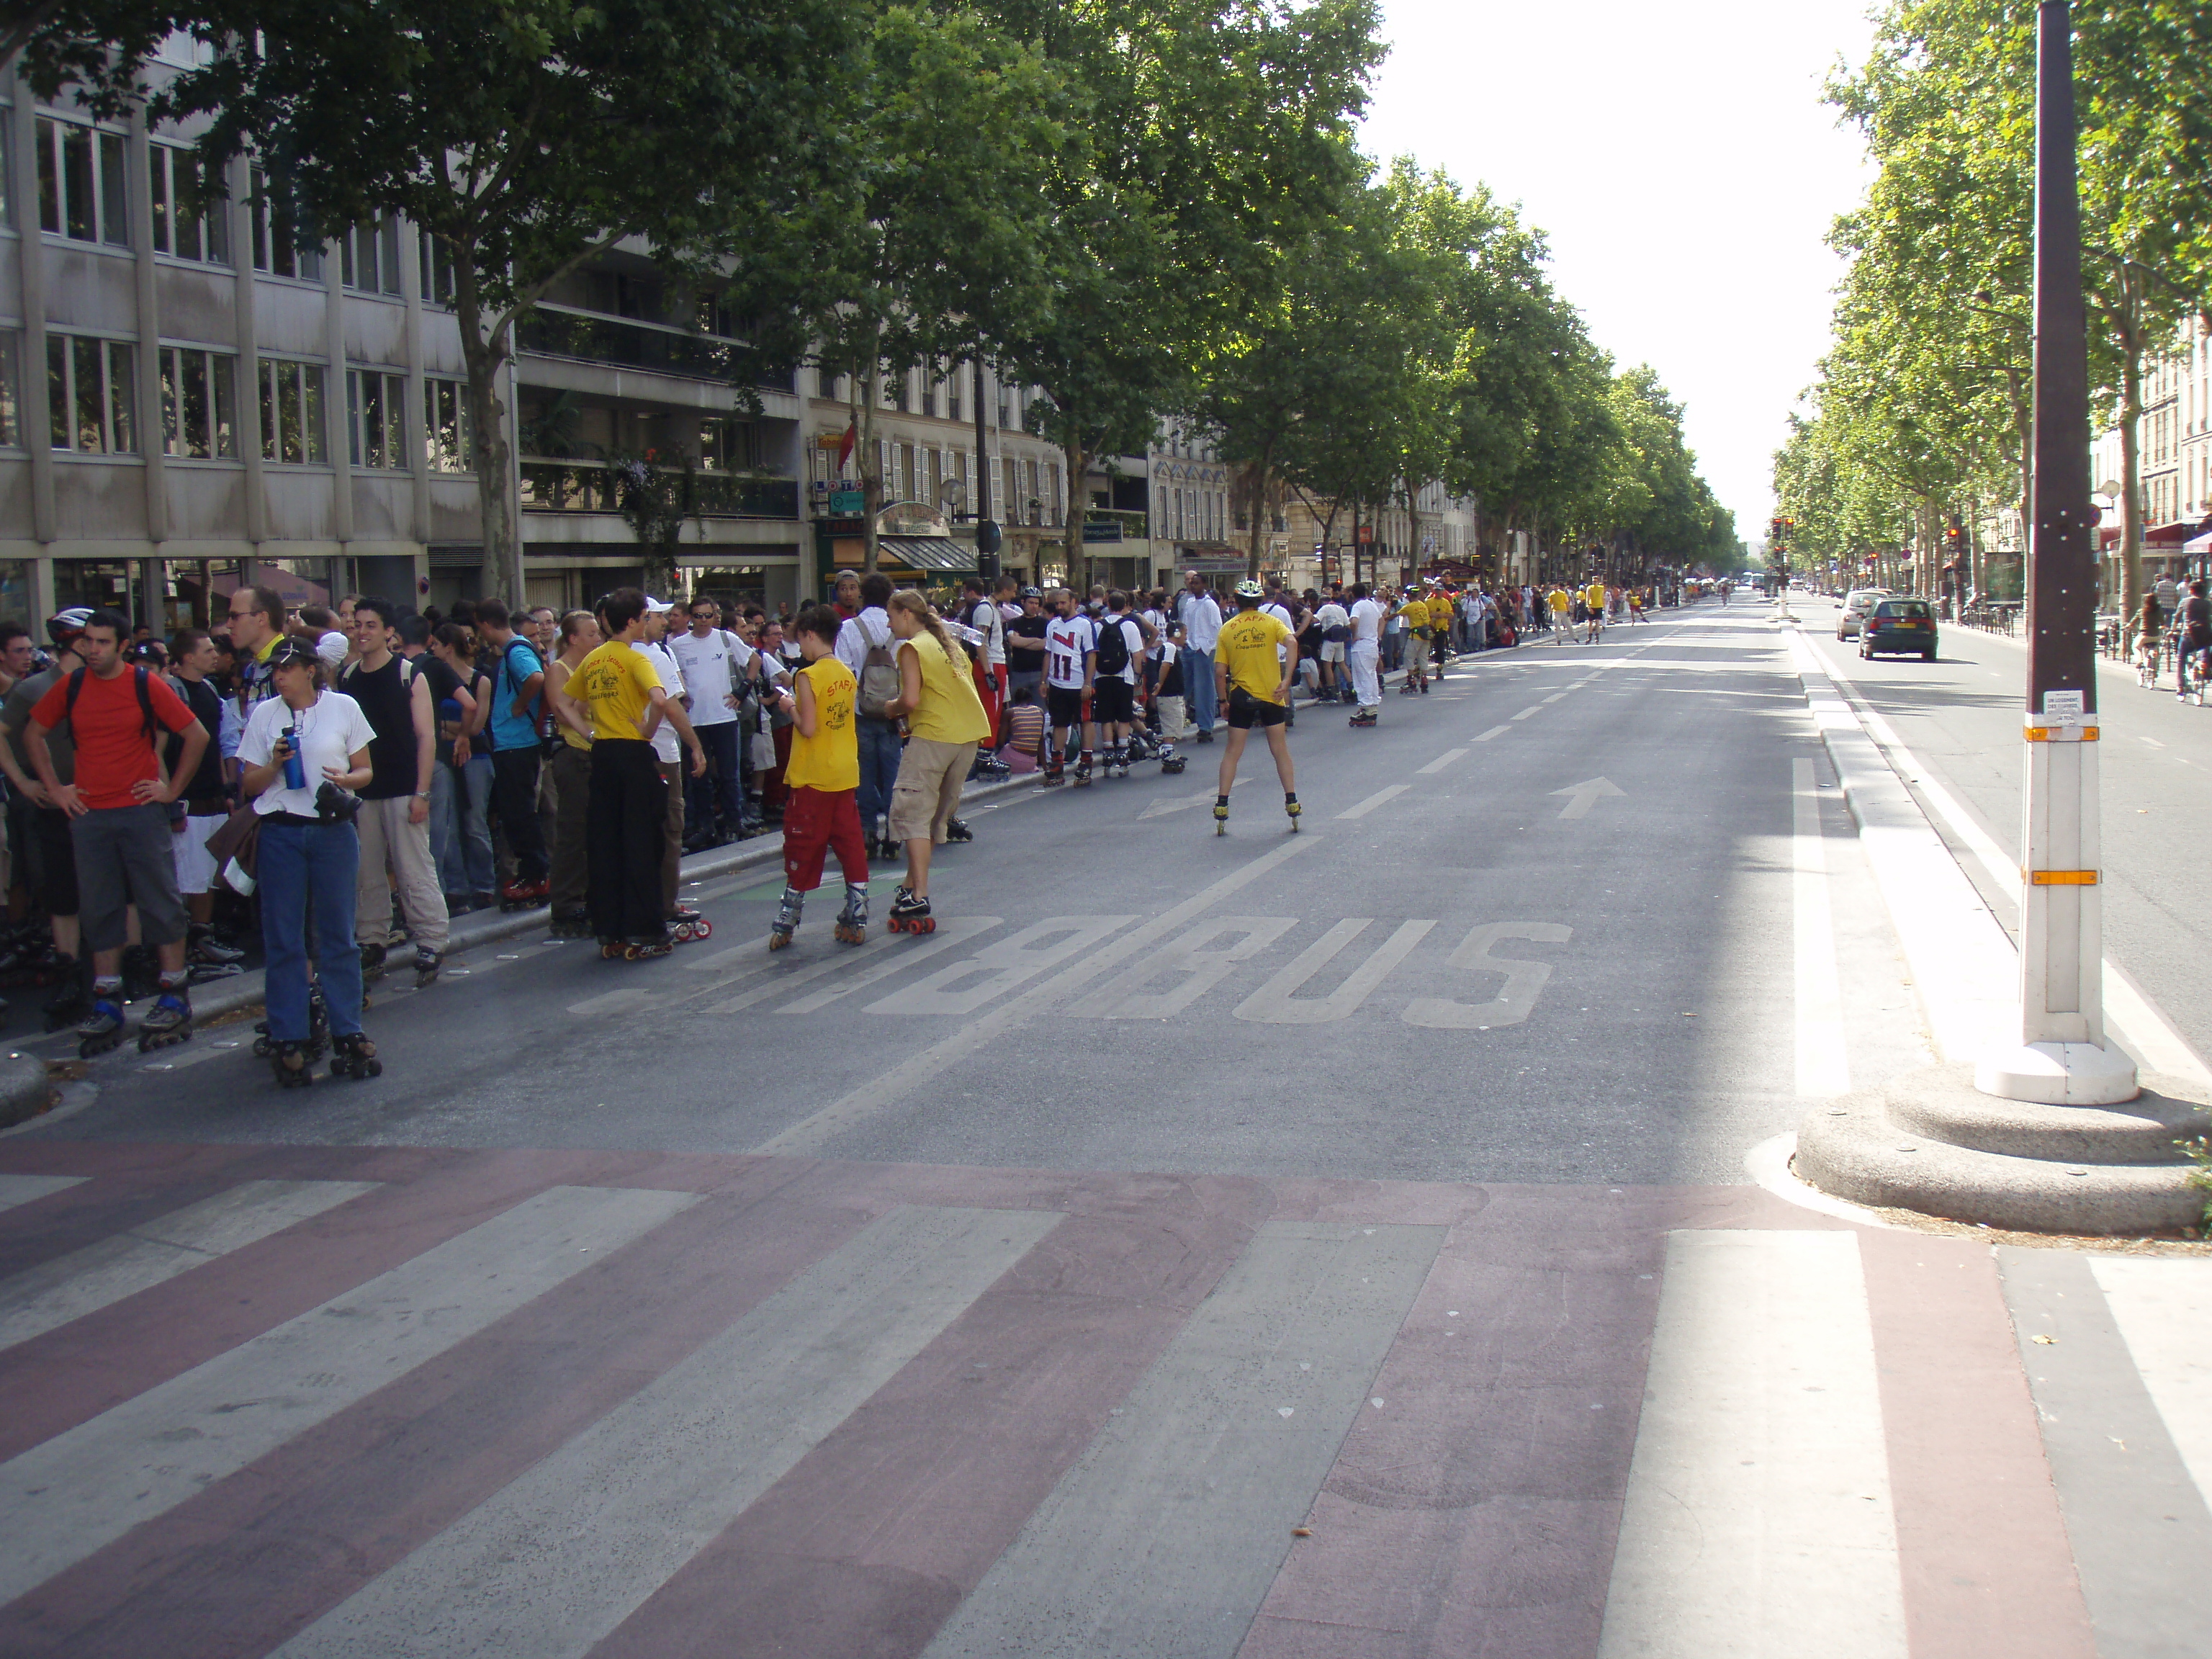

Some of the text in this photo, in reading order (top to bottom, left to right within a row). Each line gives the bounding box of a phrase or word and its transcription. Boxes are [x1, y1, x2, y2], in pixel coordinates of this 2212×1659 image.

[814, 480, 864, 492] LOTO
[1230, 615, 1266, 630] STAFF
[1061, 915, 1575, 1030] BUS
